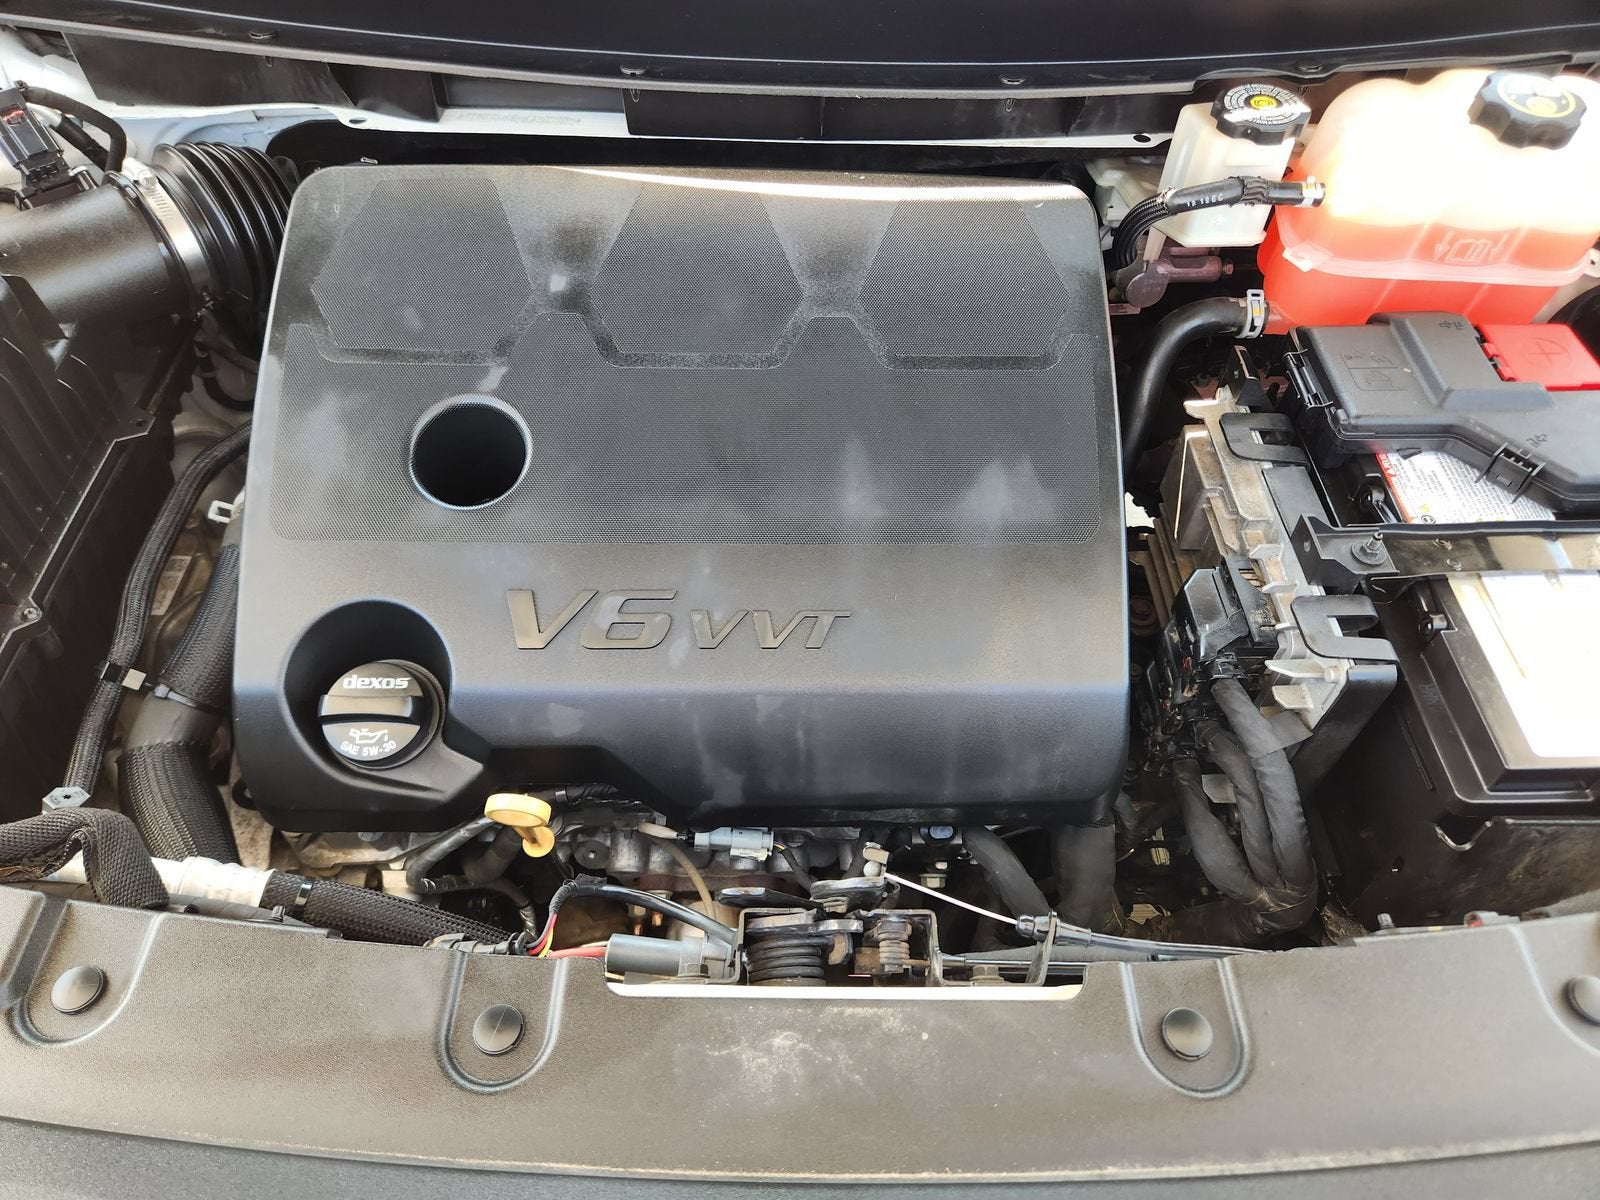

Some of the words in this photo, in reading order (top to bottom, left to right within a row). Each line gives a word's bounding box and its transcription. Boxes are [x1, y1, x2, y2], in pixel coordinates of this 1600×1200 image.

[506, 589, 677, 650] V6
[690, 609, 853, 650] VVT
[342, 674, 411, 689] dexos
[340, 741, 360, 755] SAE
[362, 740, 397, 756] 5W-30
